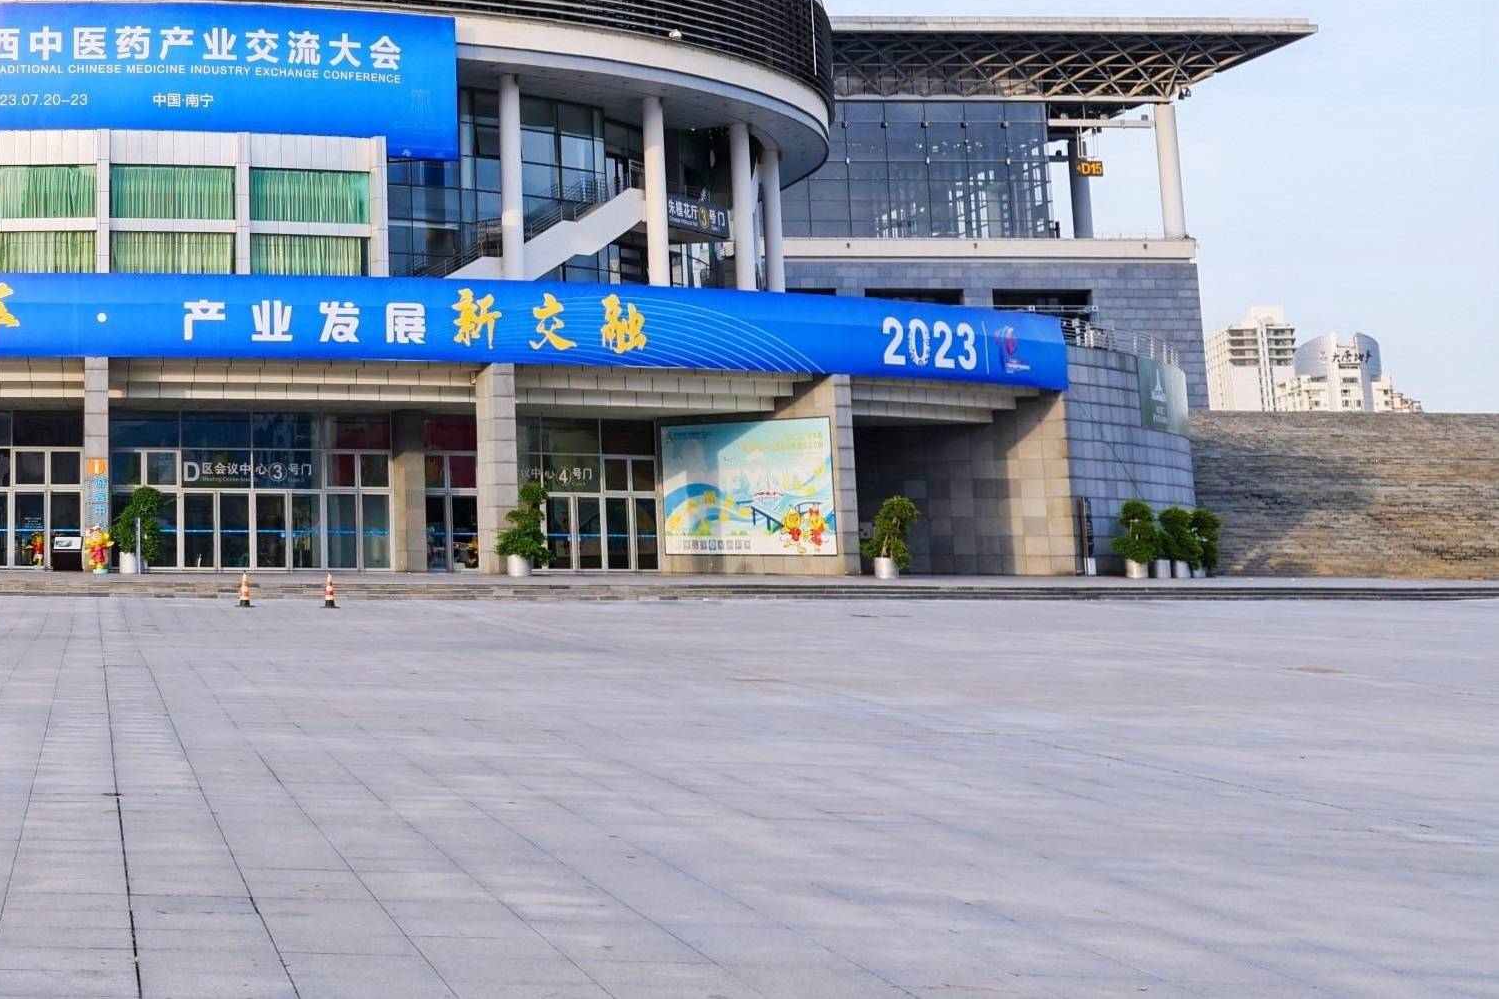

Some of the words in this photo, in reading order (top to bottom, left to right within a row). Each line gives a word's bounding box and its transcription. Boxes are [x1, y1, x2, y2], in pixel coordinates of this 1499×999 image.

[68, 64, 121, 74] CHINESE
[126, 64, 185, 74] MEDICINE
[190, 65, 251, 76] INDUSTRY
[255, 67, 319, 79] EXCHANGE
[323, 70, 401, 84] CONFERENCE
[1081, 162, 1102, 175] D15
[882, 316, 977, 371] 2023
